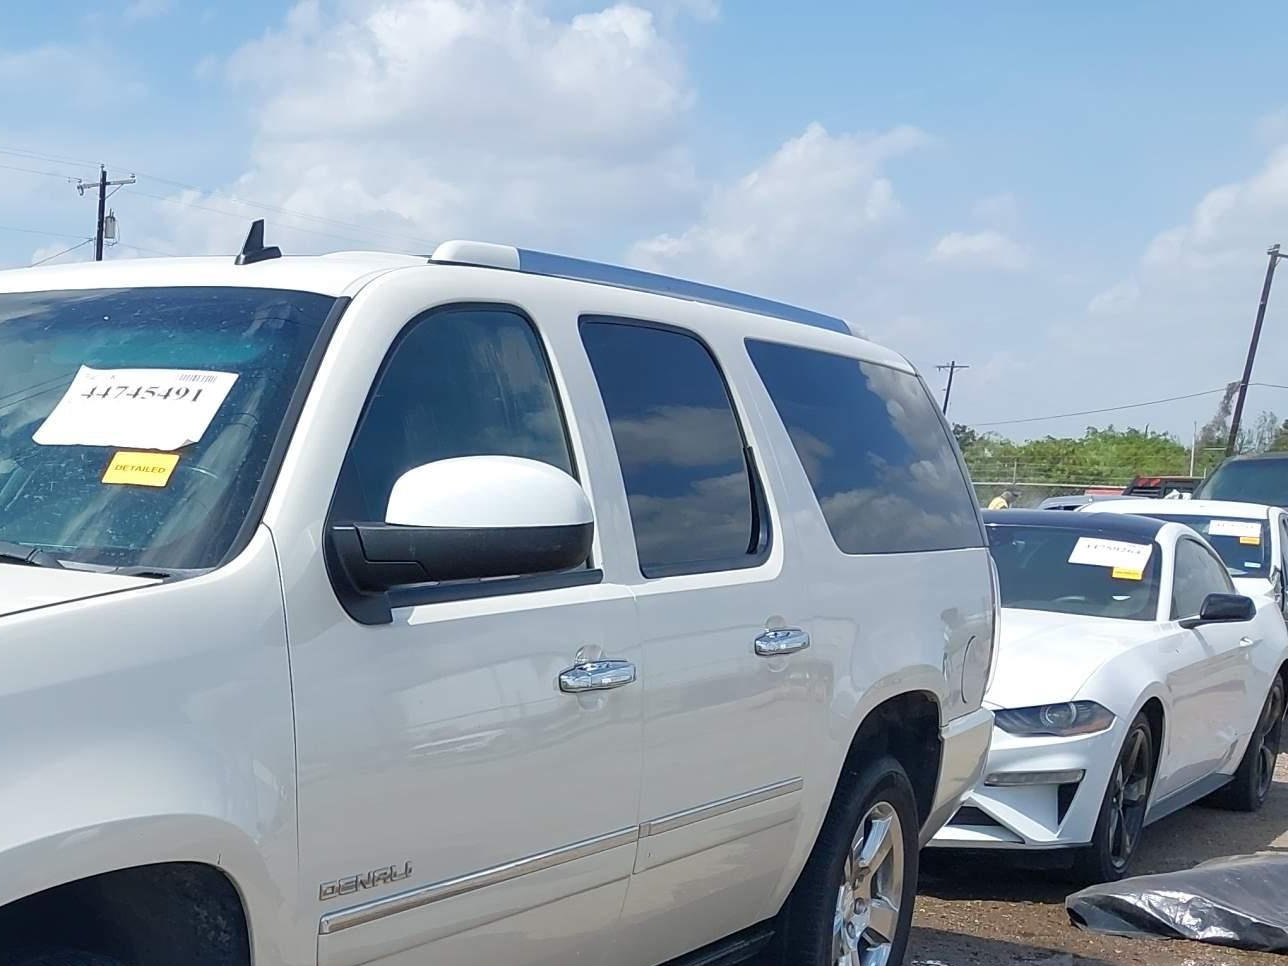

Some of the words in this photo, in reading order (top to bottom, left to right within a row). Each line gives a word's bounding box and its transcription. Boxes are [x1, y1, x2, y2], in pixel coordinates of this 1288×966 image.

[80, 385, 204, 402] 44745491
[114, 463, 167, 475] DETAILED
[319, 860, 413, 901] DENALI
